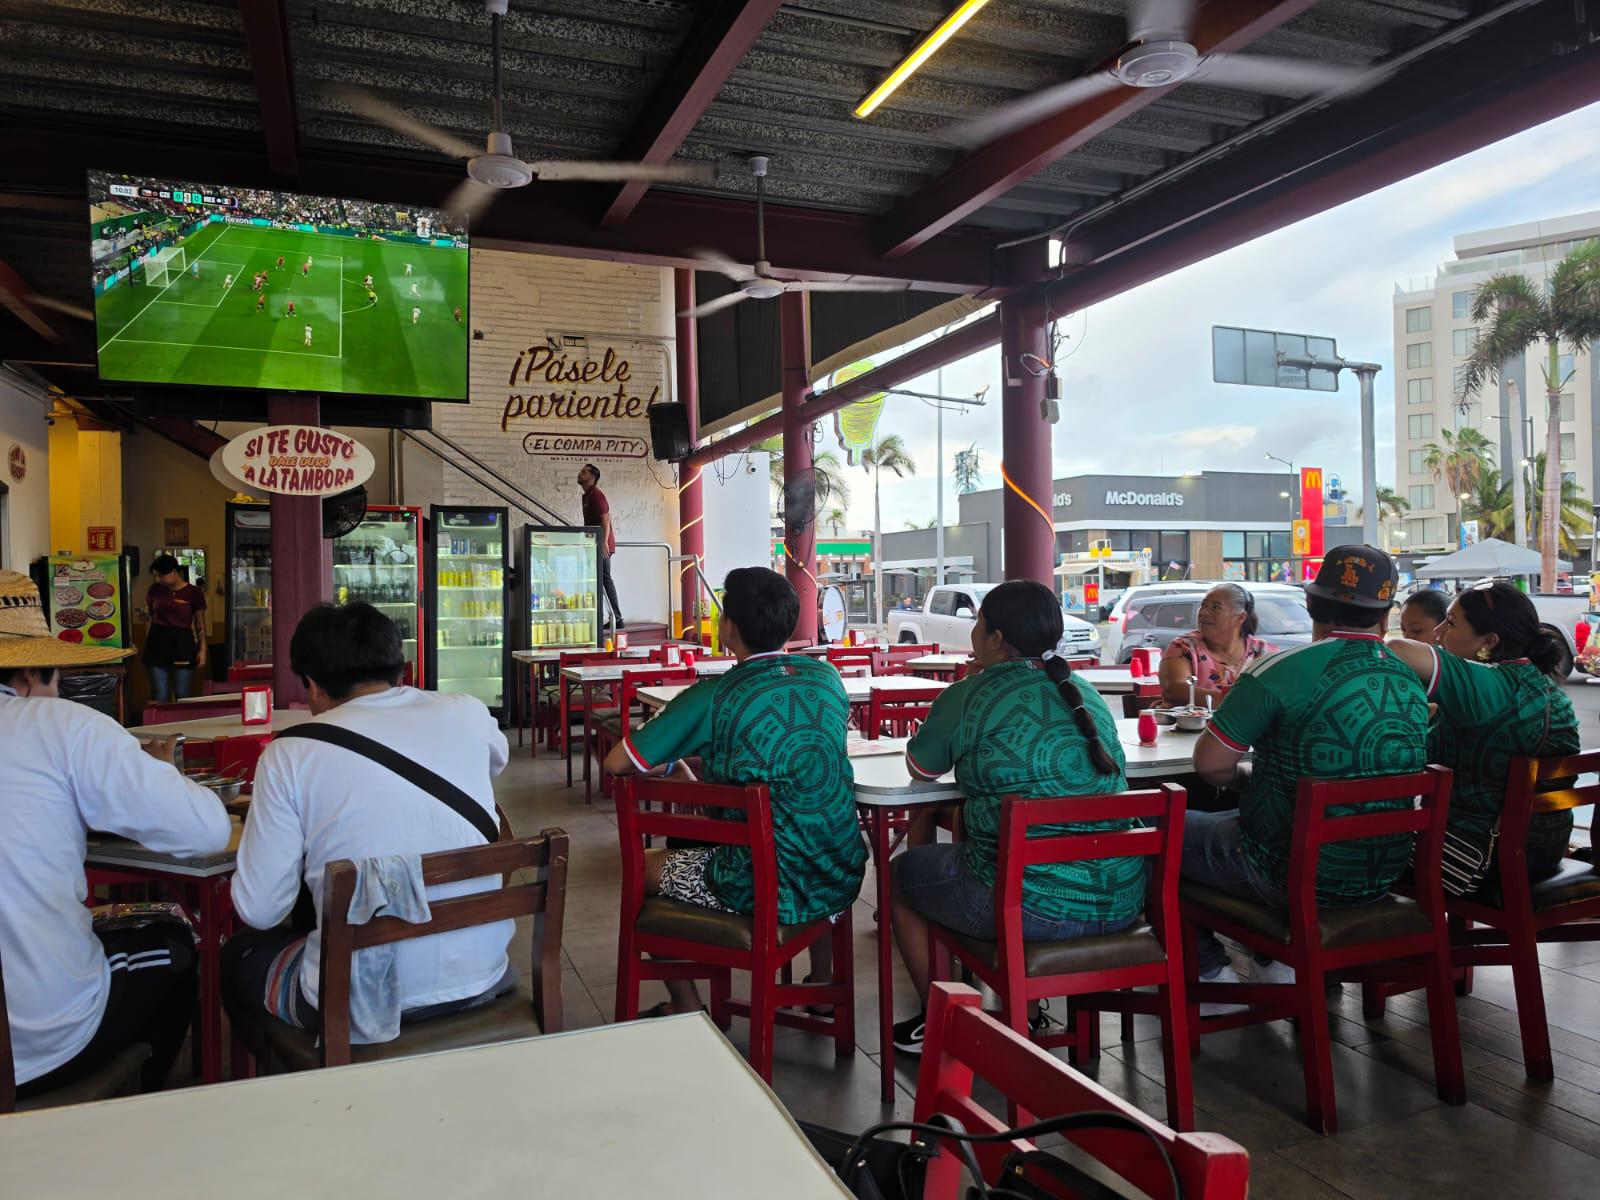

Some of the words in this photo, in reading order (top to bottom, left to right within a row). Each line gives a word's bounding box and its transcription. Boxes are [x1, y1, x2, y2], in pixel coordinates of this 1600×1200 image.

[501, 384, 659, 432] pariente!
[244, 435, 264, 458] SI
[267, 429, 290, 455] TE
[294, 428, 355, 459] GUSTÓ
[533, 438, 549, 451] EL
[553, 438, 602, 452] COMPA
[606, 439, 640, 453] PITY
[268, 456, 297, 467] DALE
[299, 456, 331, 468] DURO
[244, 467, 255, 482] A
[258, 467, 278, 489] LA
[281, 467, 354, 492] TAMBORA
[1105, 490, 1184, 506] McDonald's
